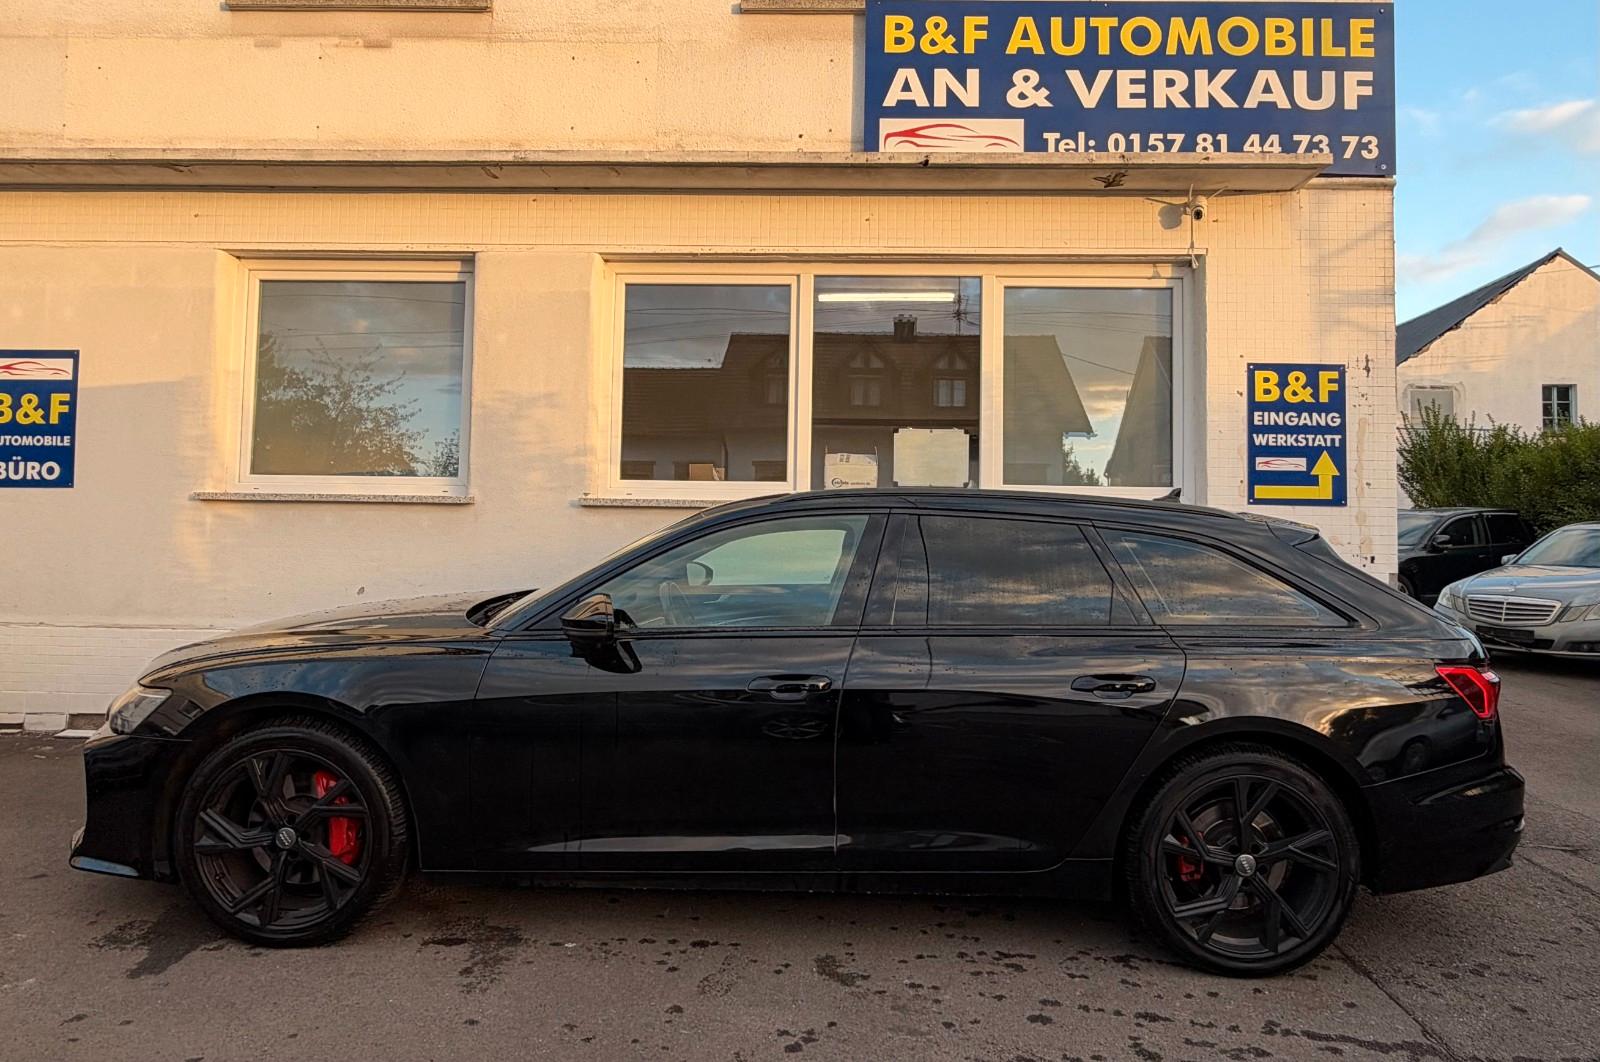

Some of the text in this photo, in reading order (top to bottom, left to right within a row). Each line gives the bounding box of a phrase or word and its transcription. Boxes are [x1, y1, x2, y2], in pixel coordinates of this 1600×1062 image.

[884, 15, 1375, 58] B&F AUTOMOBILE
[882, 67, 1375, 110] AN & VERKAUF
[1043, 132, 1379, 160] Tel: 0157 81 44 73 73
[1254, 370, 1340, 403] B&F
[1253, 411, 1342, 427] EINGANG
[0, 435, 72, 447] UTOMOBILE
[1252, 433, 1342, 448] WERKSTATT
